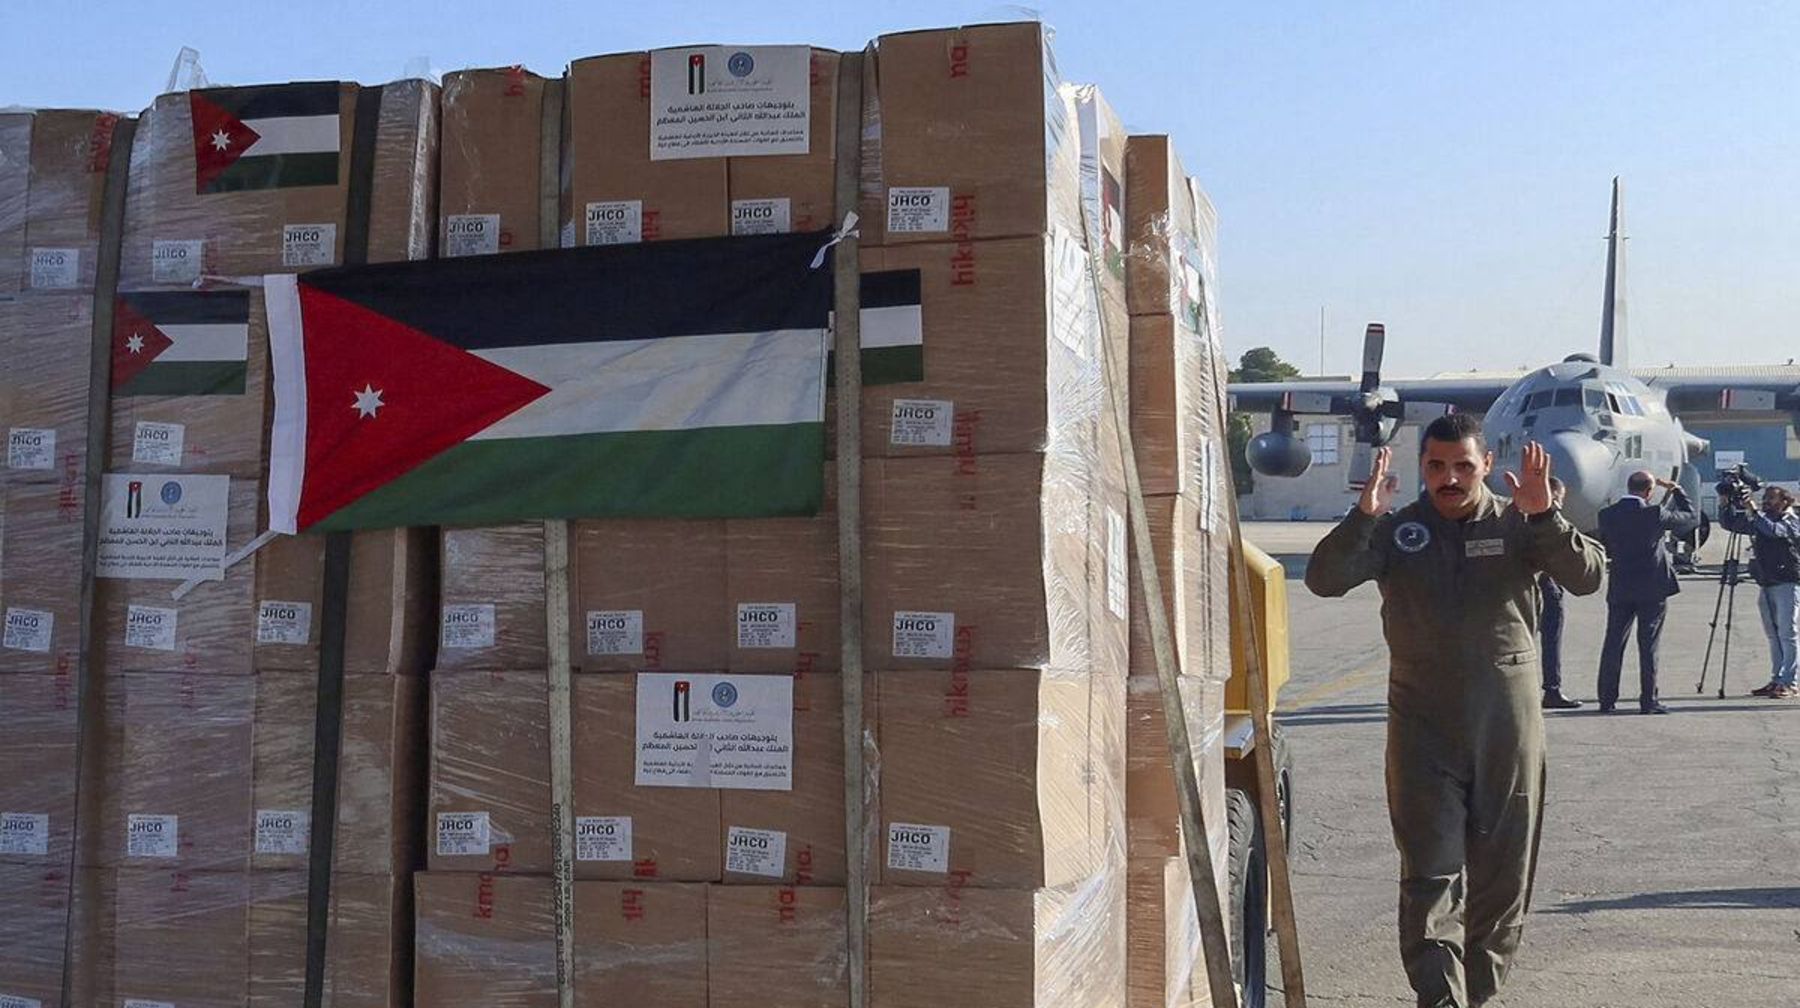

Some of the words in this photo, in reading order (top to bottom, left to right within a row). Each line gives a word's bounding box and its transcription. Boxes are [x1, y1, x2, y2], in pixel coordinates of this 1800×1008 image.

[667, 104, 705, 113] الهاشمية
[732, 102, 755, 110] صاحب
[688, 115, 715, 124] الحسين
[730, 112, 753, 122] الثاني
[754, 112, 780, 120] عبدالله
[783, 110, 806, 119] الملك
[657, 117, 686, 126] المعظم
[891, 196, 930, 207] JHCO
[589, 210, 624, 221] JHCO
[735, 207, 771, 218] JHCO
[449, 221, 483, 233] JHCO
[286, 231, 319, 242] JHCO
[895, 407, 934, 419] JHCO
[136, 428, 168, 440] JHCO
[129, 613, 161, 624] JHCO
[262, 608, 295, 619] JHCO
[445, 613, 478, 623] JHCO
[740, 611, 777, 622] JHCO
[8, 614, 38, 627] JHCO
[590, 618, 625, 629] JHCO
[896, 620, 935, 631] JHCO
[653, 731, 689, 740] الهاشمية
[717, 733, 739, 741] صاحب
[740, 734, 778, 743] بتوجيهات
[642, 741, 672, 751] المعظم
[714, 743, 736, 754] الثاني
[738, 743, 763, 752] عبدالله
[766, 744, 789, 752] الملك
[3, 820, 33, 830] JHCO
[130, 822, 162, 832] JHCO
[259, 819, 291, 828] JHCO
[439, 818, 473, 830] JHCO
[579, 824, 614, 835] JHCO
[730, 836, 767, 848] JHCO
[891, 831, 930, 844] JHCO
